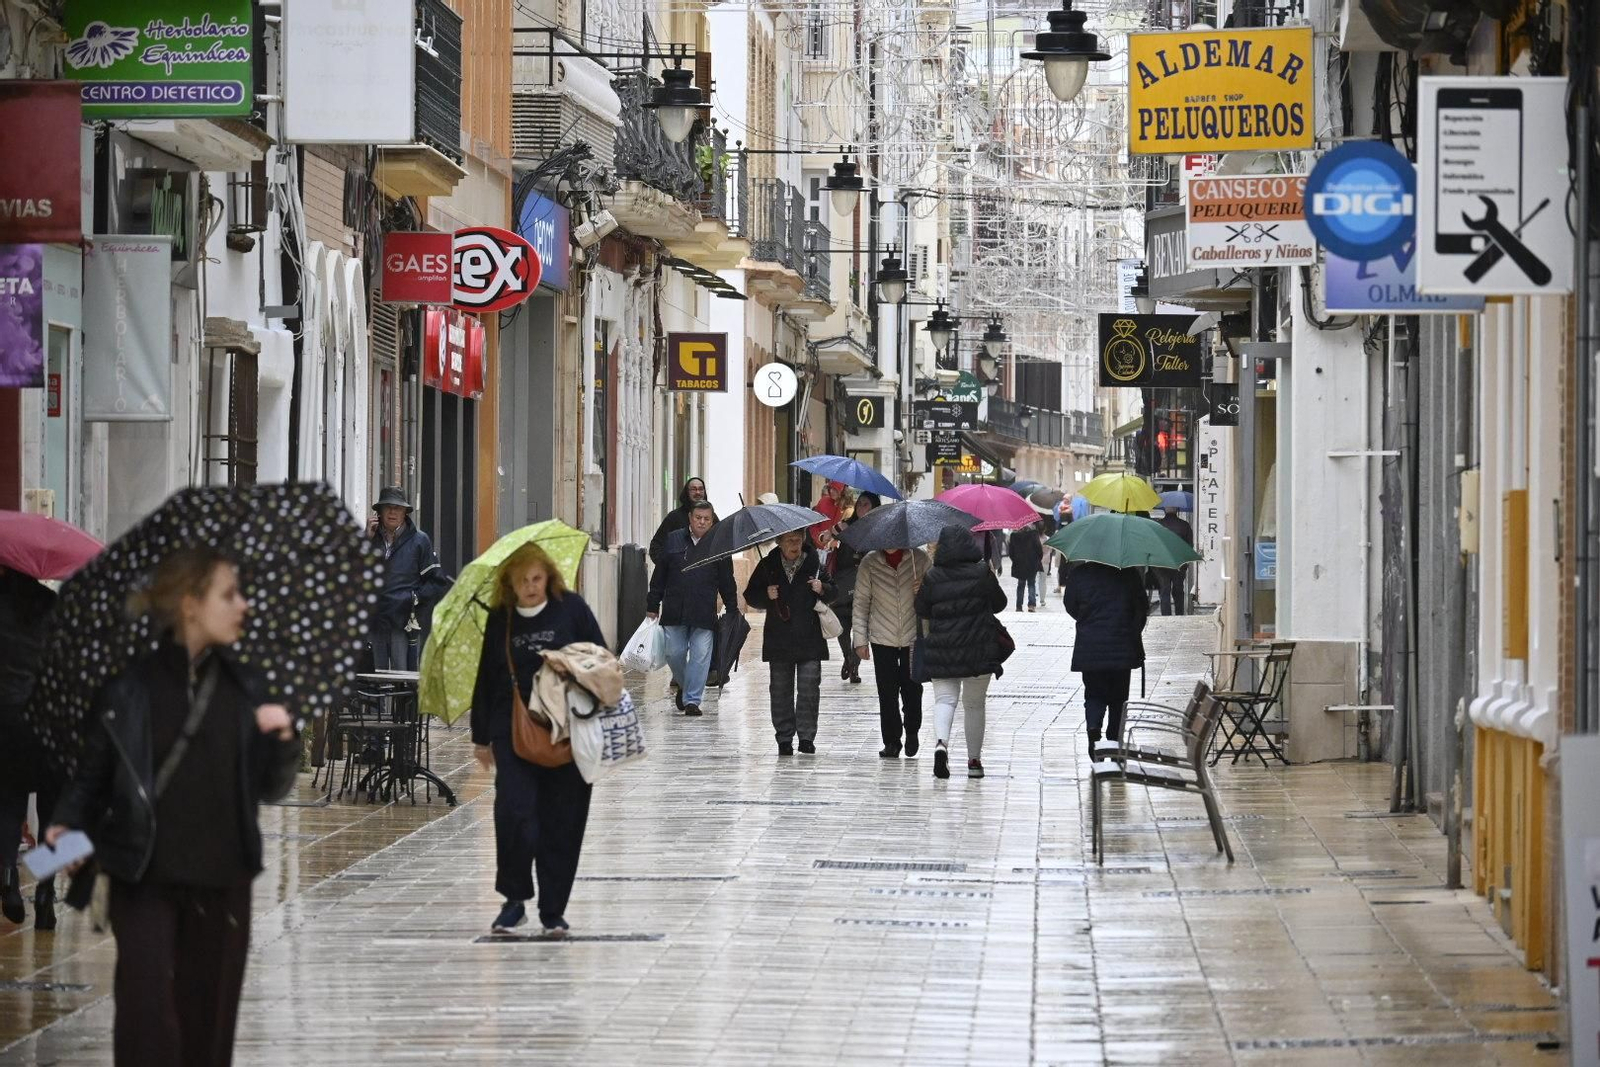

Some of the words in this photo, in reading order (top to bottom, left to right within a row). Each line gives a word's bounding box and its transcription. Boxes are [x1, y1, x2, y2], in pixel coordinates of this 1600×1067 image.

[145, 14, 248, 38] Herbolario
[139, 41, 248, 75] Equinácea
[1136, 39, 1304, 89] ALDEMAR
[81, 85, 146, 99] CENTRO
[152, 85, 235, 99] DIETETICO
[1184, 95, 1216, 103] BARBER
[1224, 94, 1244, 102] SHOP
[1138, 102, 1304, 140] PELUQUEROS
[1313, 193, 1413, 215] DIGI
[386, 253, 448, 273] GAES
[1192, 245, 1261, 261] Caballeros
[1263, 249, 1272, 263] y
[1276, 243, 1312, 259] Niños
[1153, 354, 1189, 372] Taller
[676, 379, 718, 389] TABACOS
